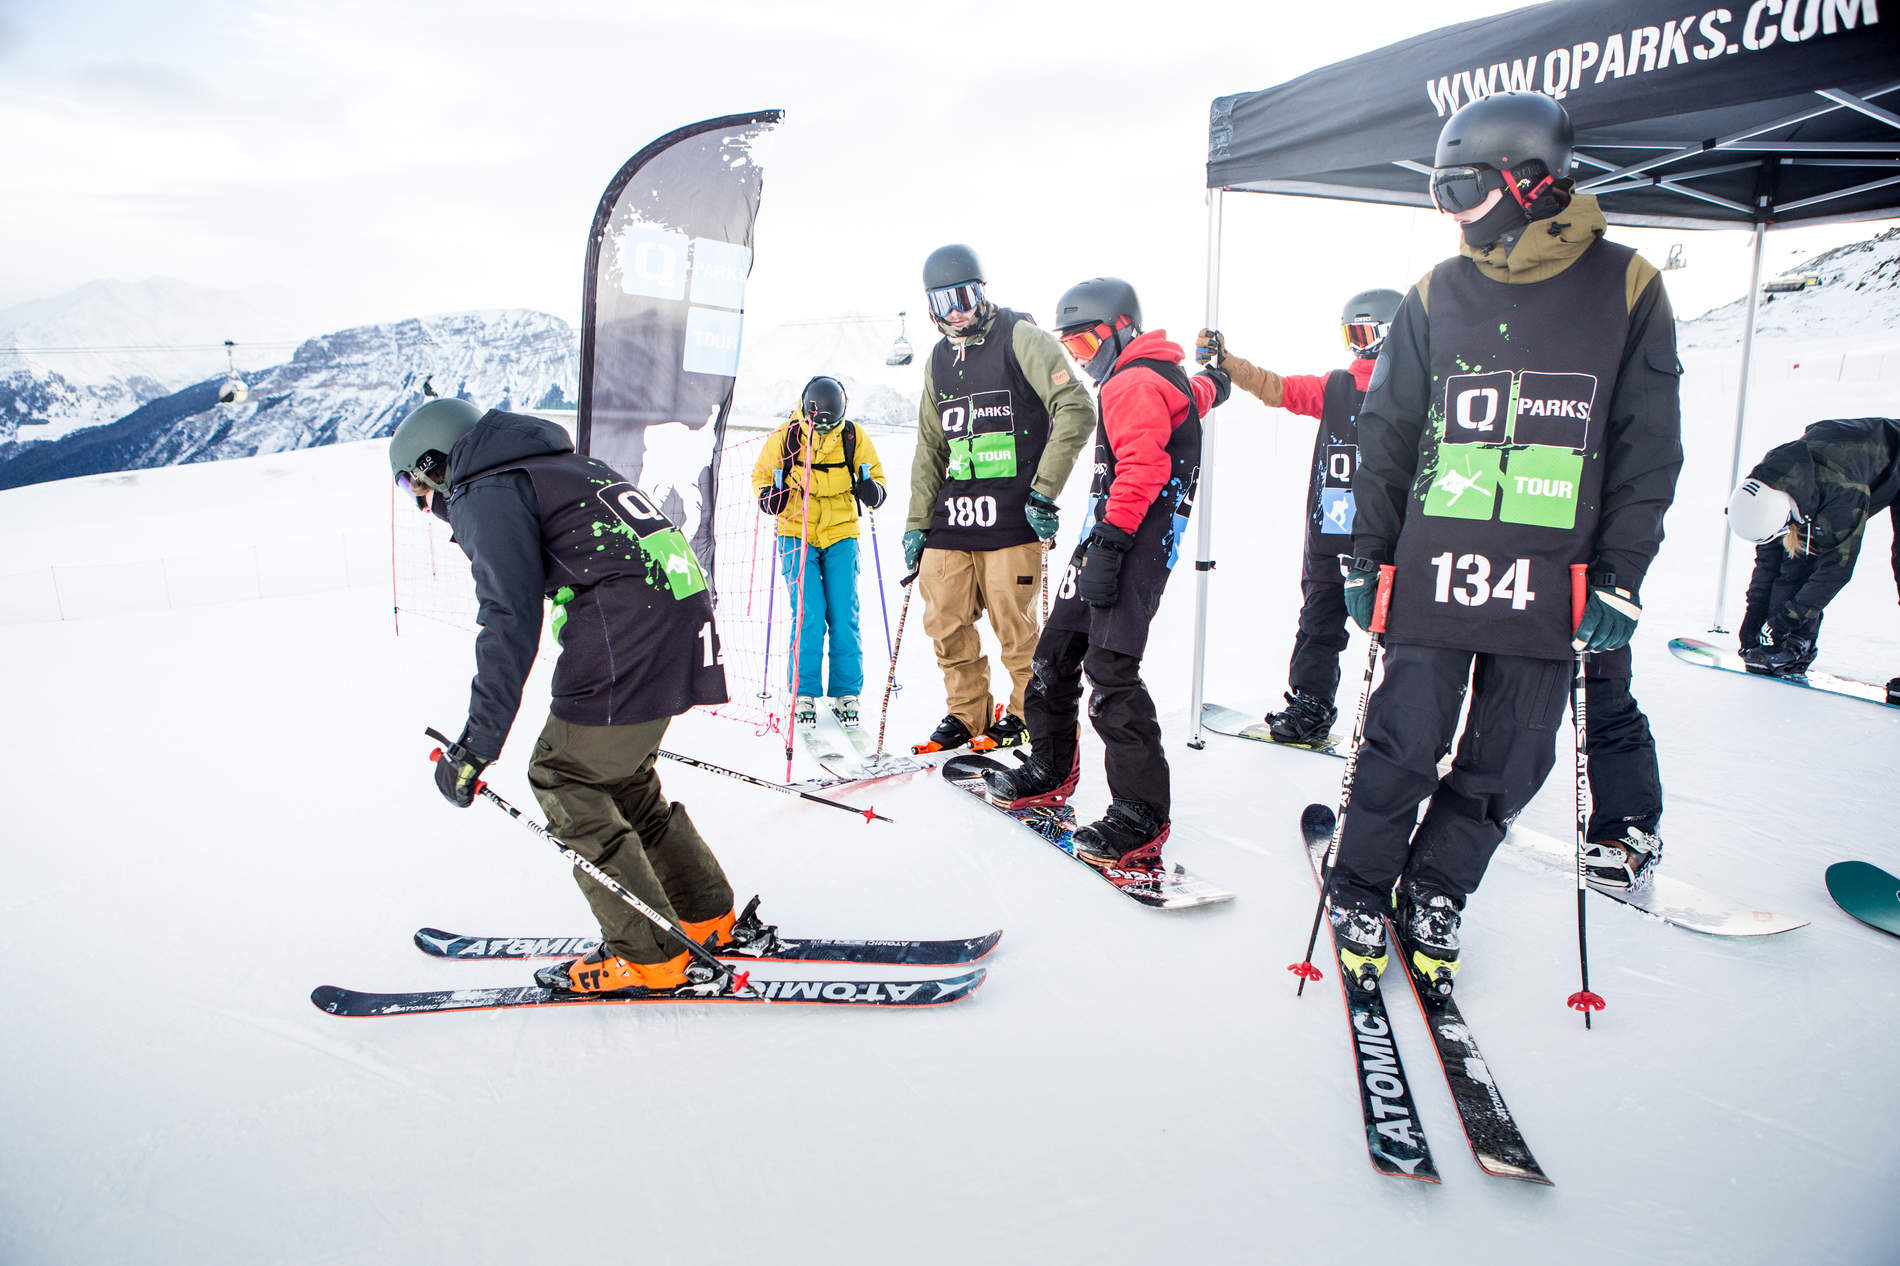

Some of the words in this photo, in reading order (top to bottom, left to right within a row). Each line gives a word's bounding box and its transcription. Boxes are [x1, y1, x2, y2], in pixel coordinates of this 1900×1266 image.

[1426, 0, 1879, 117] WWWQPARKS.COM
[942, 406, 965, 432] Q
[973, 405, 1010, 420] PARKS
[1457, 388, 1498, 431] Q
[1517, 397, 1590, 420] PARKS
[977, 450, 1011, 462] TOUR
[1329, 453, 1350, 482] Q
[1513, 475, 1573, 499] TOUR
[617, 489, 664, 521] Q
[944, 495, 997, 527] 180
[1431, 552, 1536, 611] 134
[1576, 752, 1588, 823] ATOMIC
[563, 849, 620, 892] ATOMIC
[458, 937, 600, 956] ATOMIC
[735, 981, 922, 1001] ATOMIC
[1354, 1012, 1418, 1148] ATOMIC
